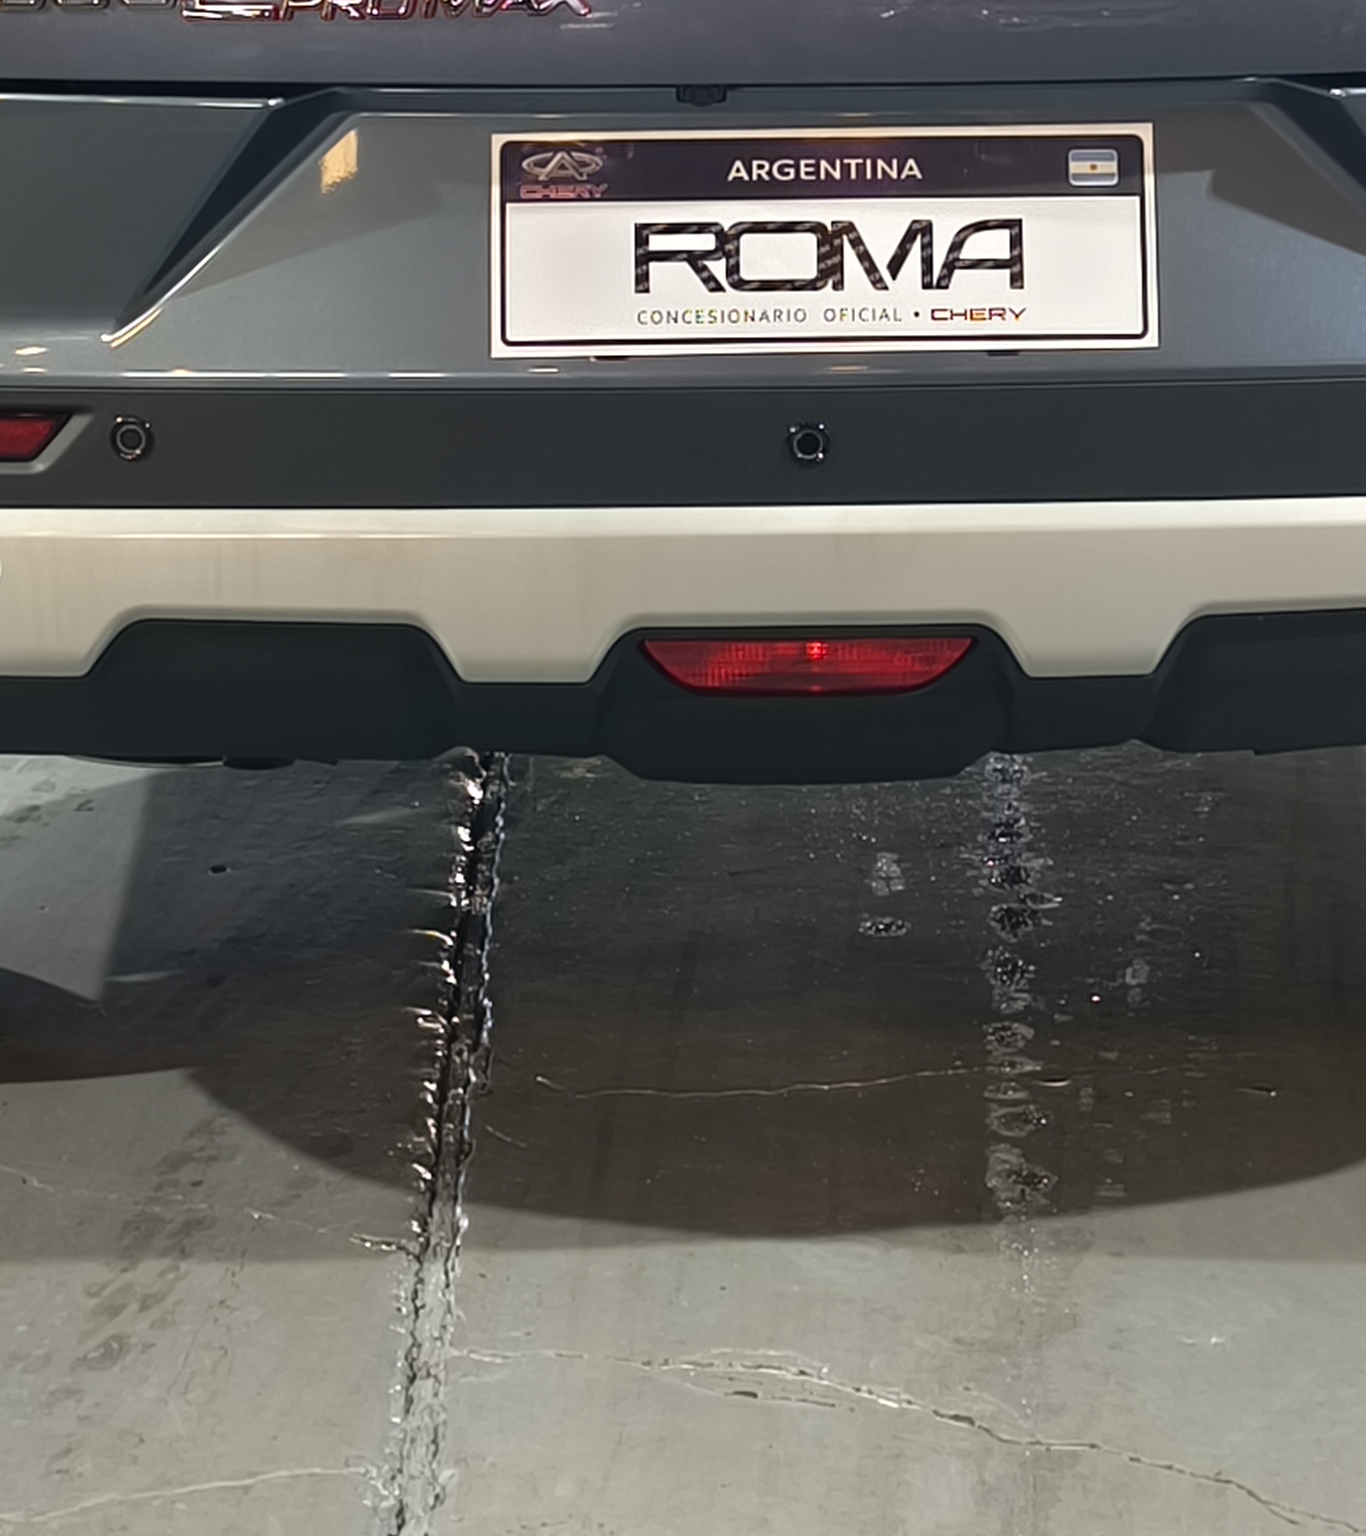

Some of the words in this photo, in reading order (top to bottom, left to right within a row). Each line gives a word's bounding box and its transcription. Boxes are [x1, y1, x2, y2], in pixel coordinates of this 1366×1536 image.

[726, 157, 923, 183] ARGENTINA
[520, 184, 609, 200] CHERY
[633, 218, 1025, 294] ROMA
[636, 308, 808, 326] CONCESIONARIO
[823, 307, 903, 323] OFICIAL
[930, 307, 1027, 322] CHERY
